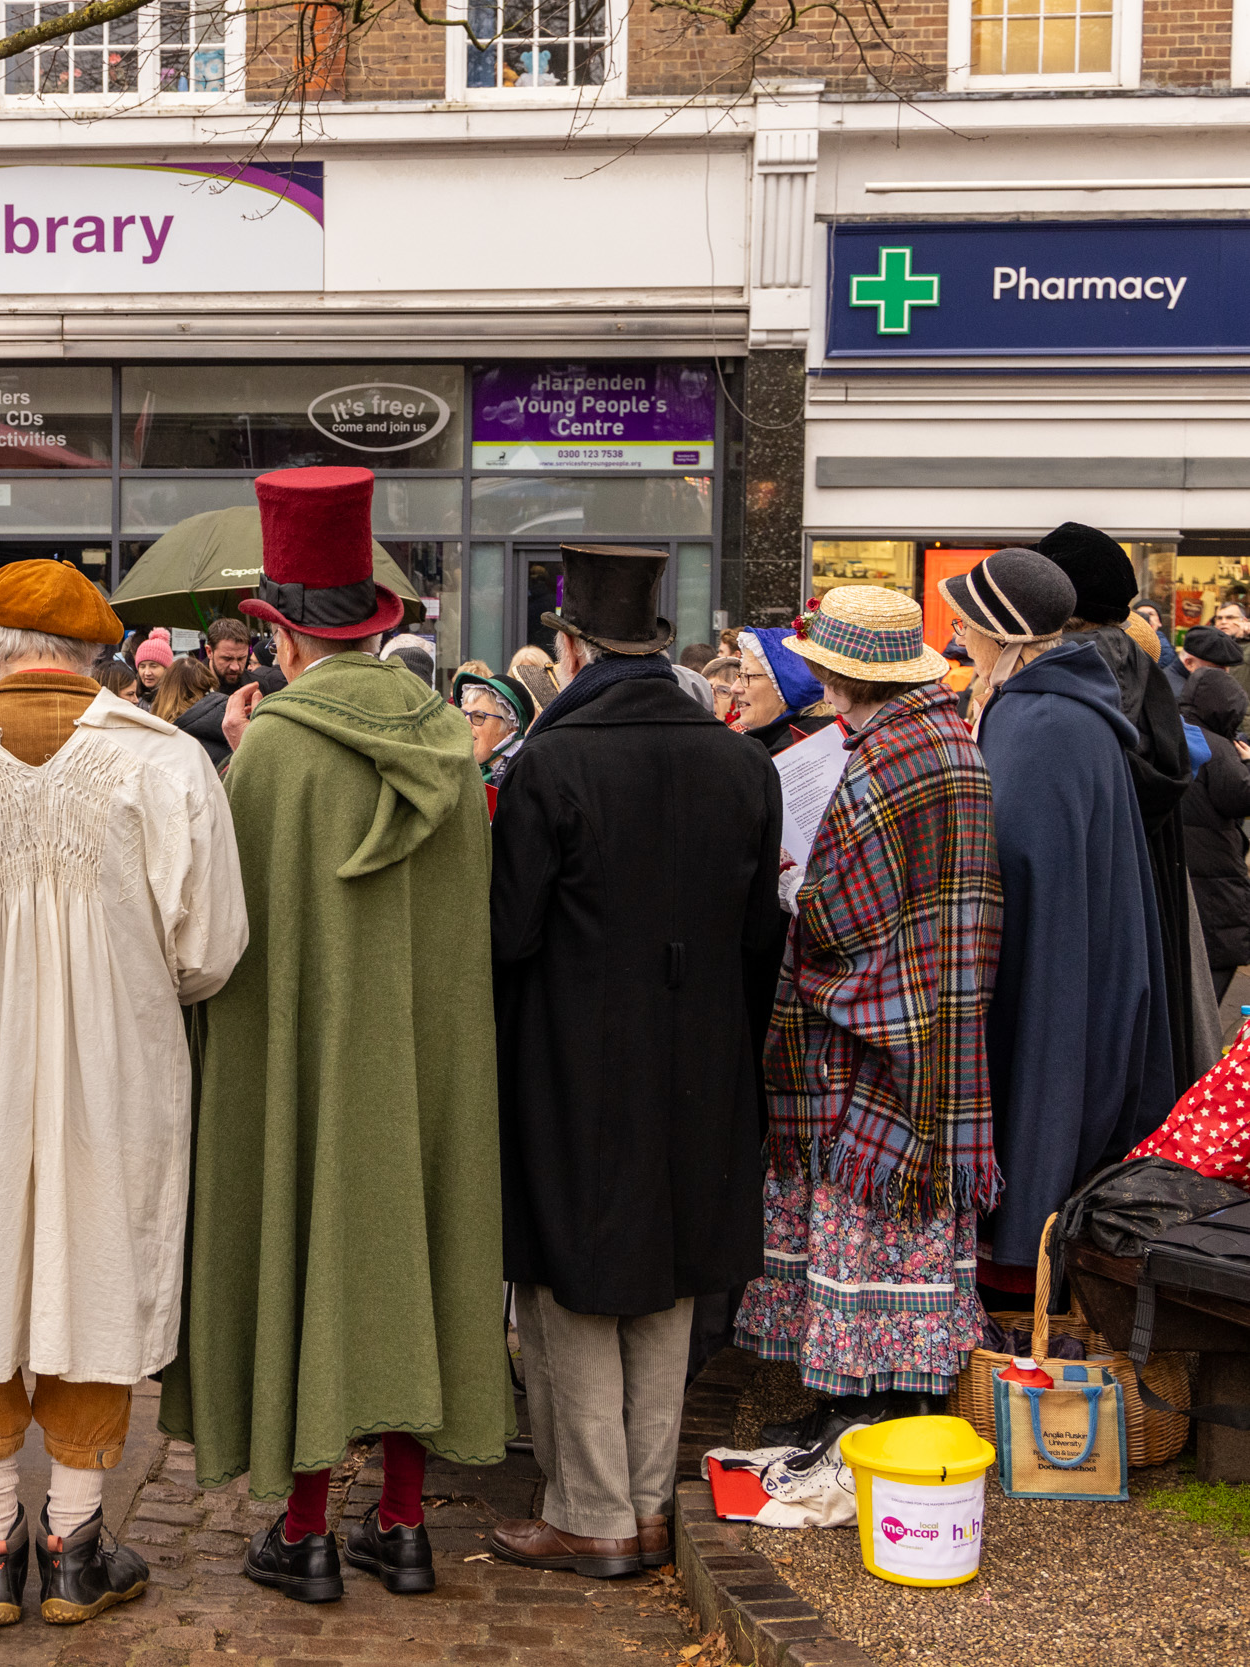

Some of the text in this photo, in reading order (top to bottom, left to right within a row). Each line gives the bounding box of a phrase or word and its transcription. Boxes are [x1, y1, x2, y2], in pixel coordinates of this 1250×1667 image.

[993, 266, 1187, 310] Pharmacy
[537, 374, 646, 394] Harpenden
[331, 395, 425, 422] It's free!
[515, 395, 667, 417] Young People's
[6, 410, 43, 426] CDs
[332, 421, 426, 434] come and join us
[557, 419, 624, 436] Centre
[558, 450, 623, 459] 0300 123 7538
[1043, 1431, 1063, 1439] Anglia
[1049, 1440, 1082, 1448] University
[882, 1521, 939, 1541] mencap
